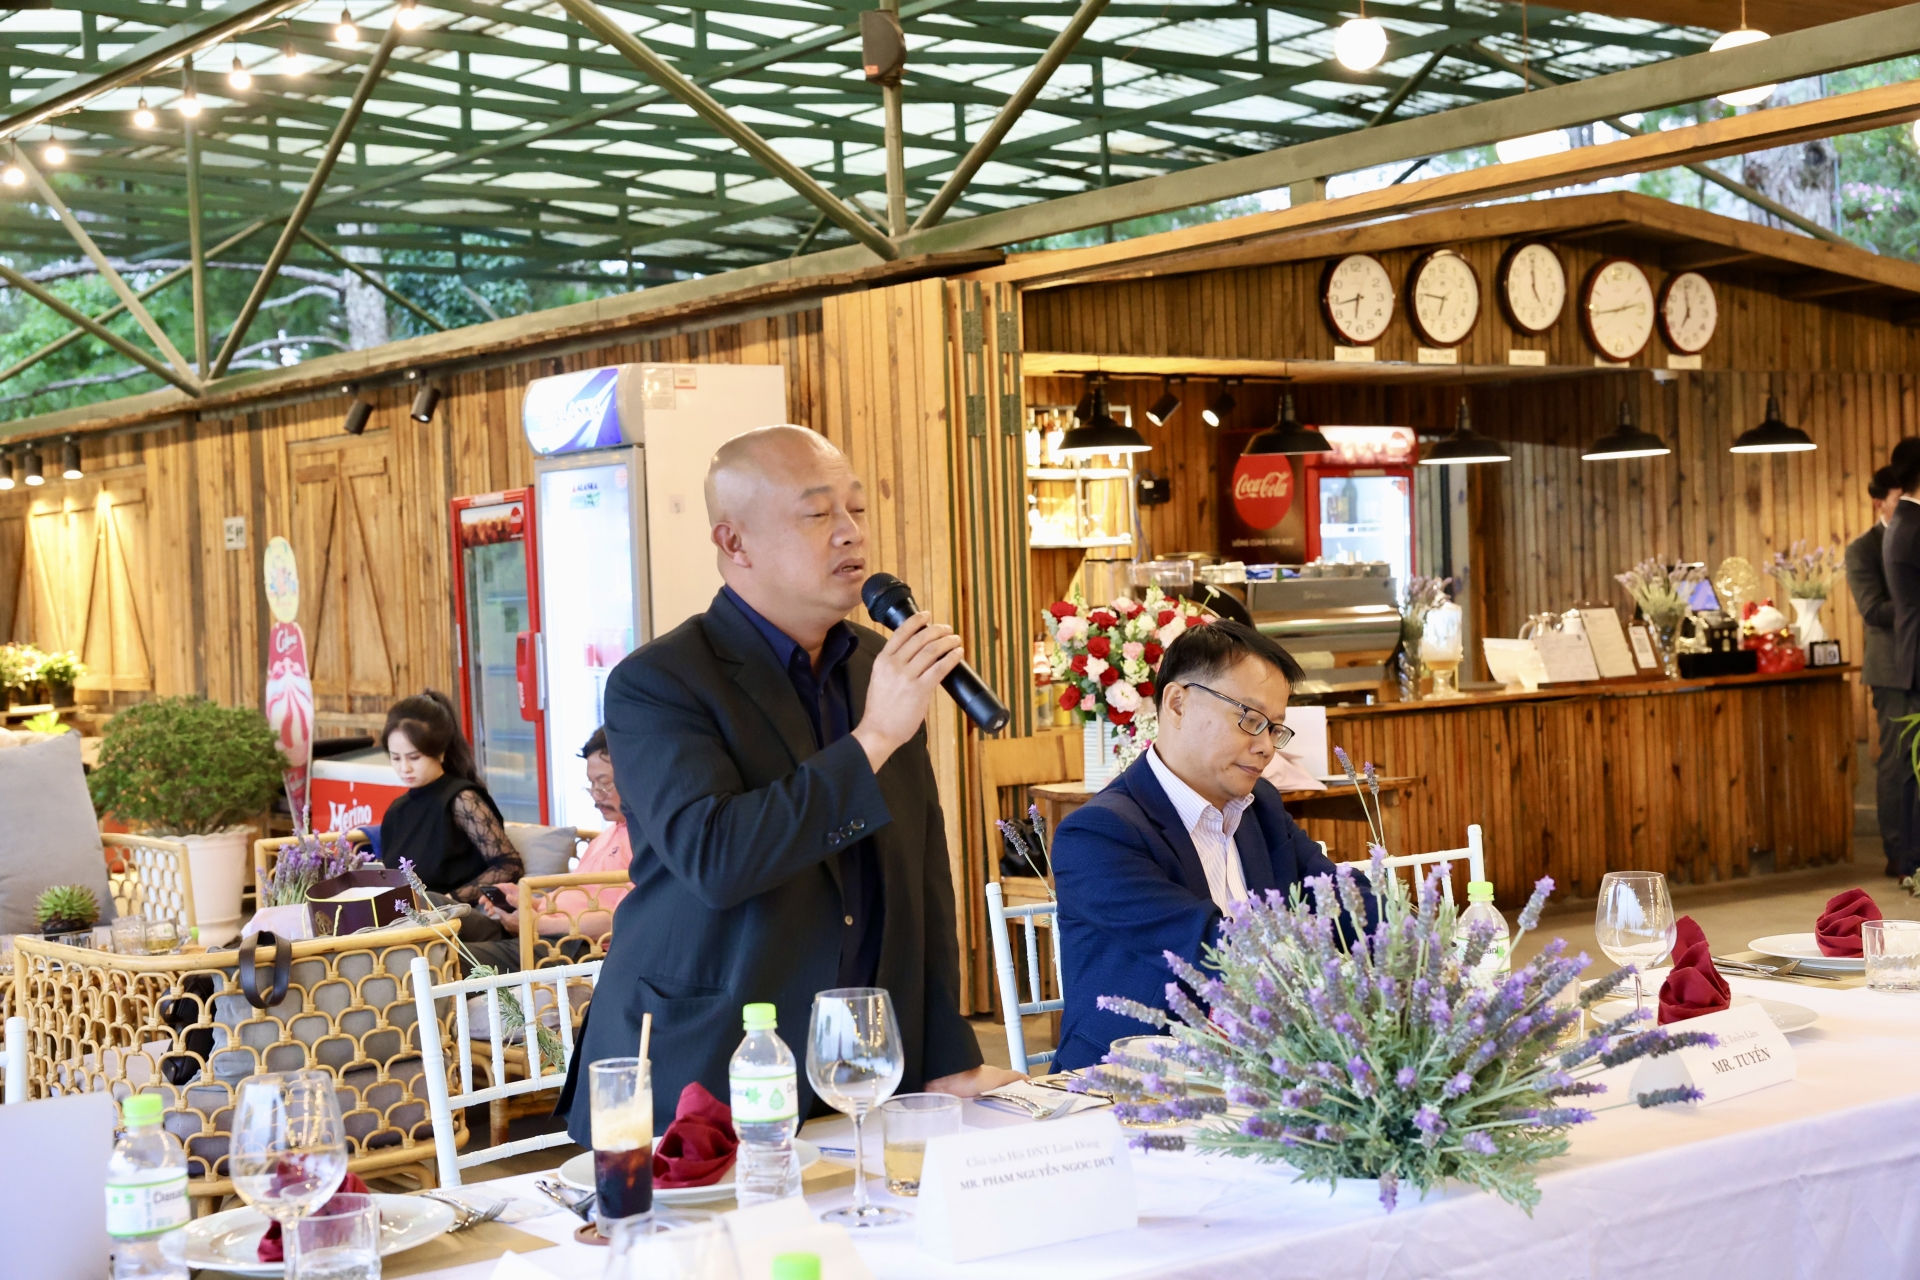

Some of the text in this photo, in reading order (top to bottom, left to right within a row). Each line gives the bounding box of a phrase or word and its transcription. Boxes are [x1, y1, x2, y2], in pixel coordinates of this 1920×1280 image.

[1349, 262, 1361, 272] 12
[1366, 267, 1370, 275] 1
[1372, 279, 1380, 288] 2
[1376, 293, 1384, 303] 3
[1335, 310, 1343, 320] 8
[1375, 308, 1382, 317] 4
[1345, 321, 1352, 330] 7
[1356, 325, 1364, 335] 6
[1367, 321, 1375, 330] 5
[1235, 472, 1290, 500] Coca-Cola
[328, 798, 372, 833] Merino
[1712, 1058, 1735, 1074] MR.
[960, 1178, 980, 1191] MR.
[1094, 1155, 1116, 1169] DUY
